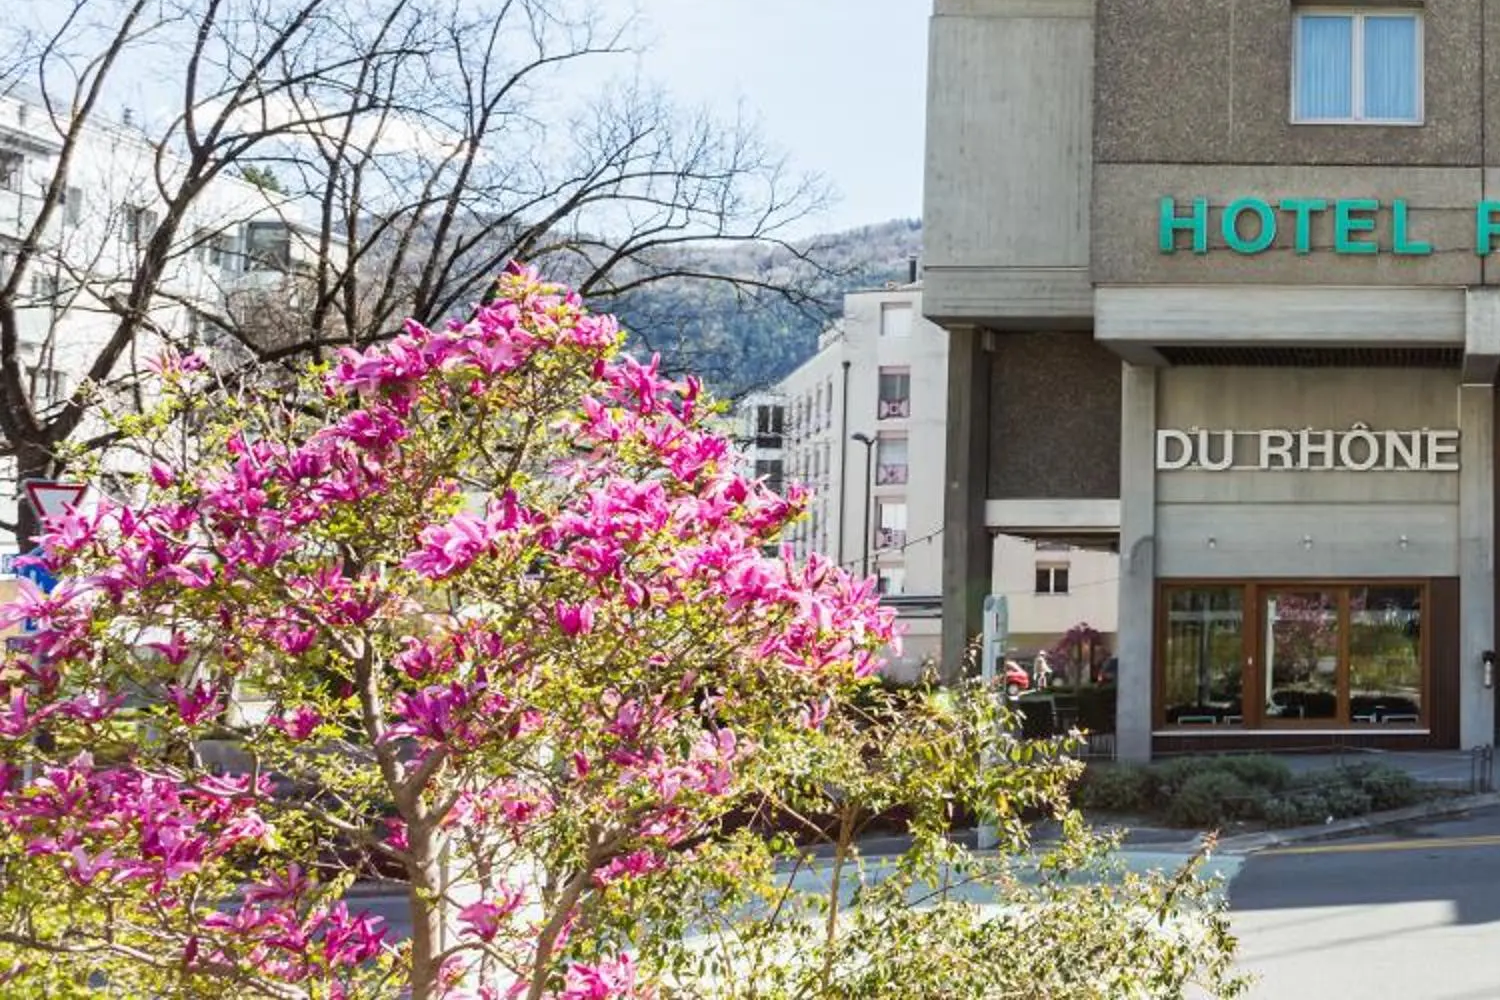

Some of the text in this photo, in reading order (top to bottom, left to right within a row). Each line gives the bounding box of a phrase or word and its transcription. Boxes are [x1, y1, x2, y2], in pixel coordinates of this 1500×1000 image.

[1159, 196, 1433, 255] HOTEL
[1156, 421, 1460, 471] DU RHÔNE
